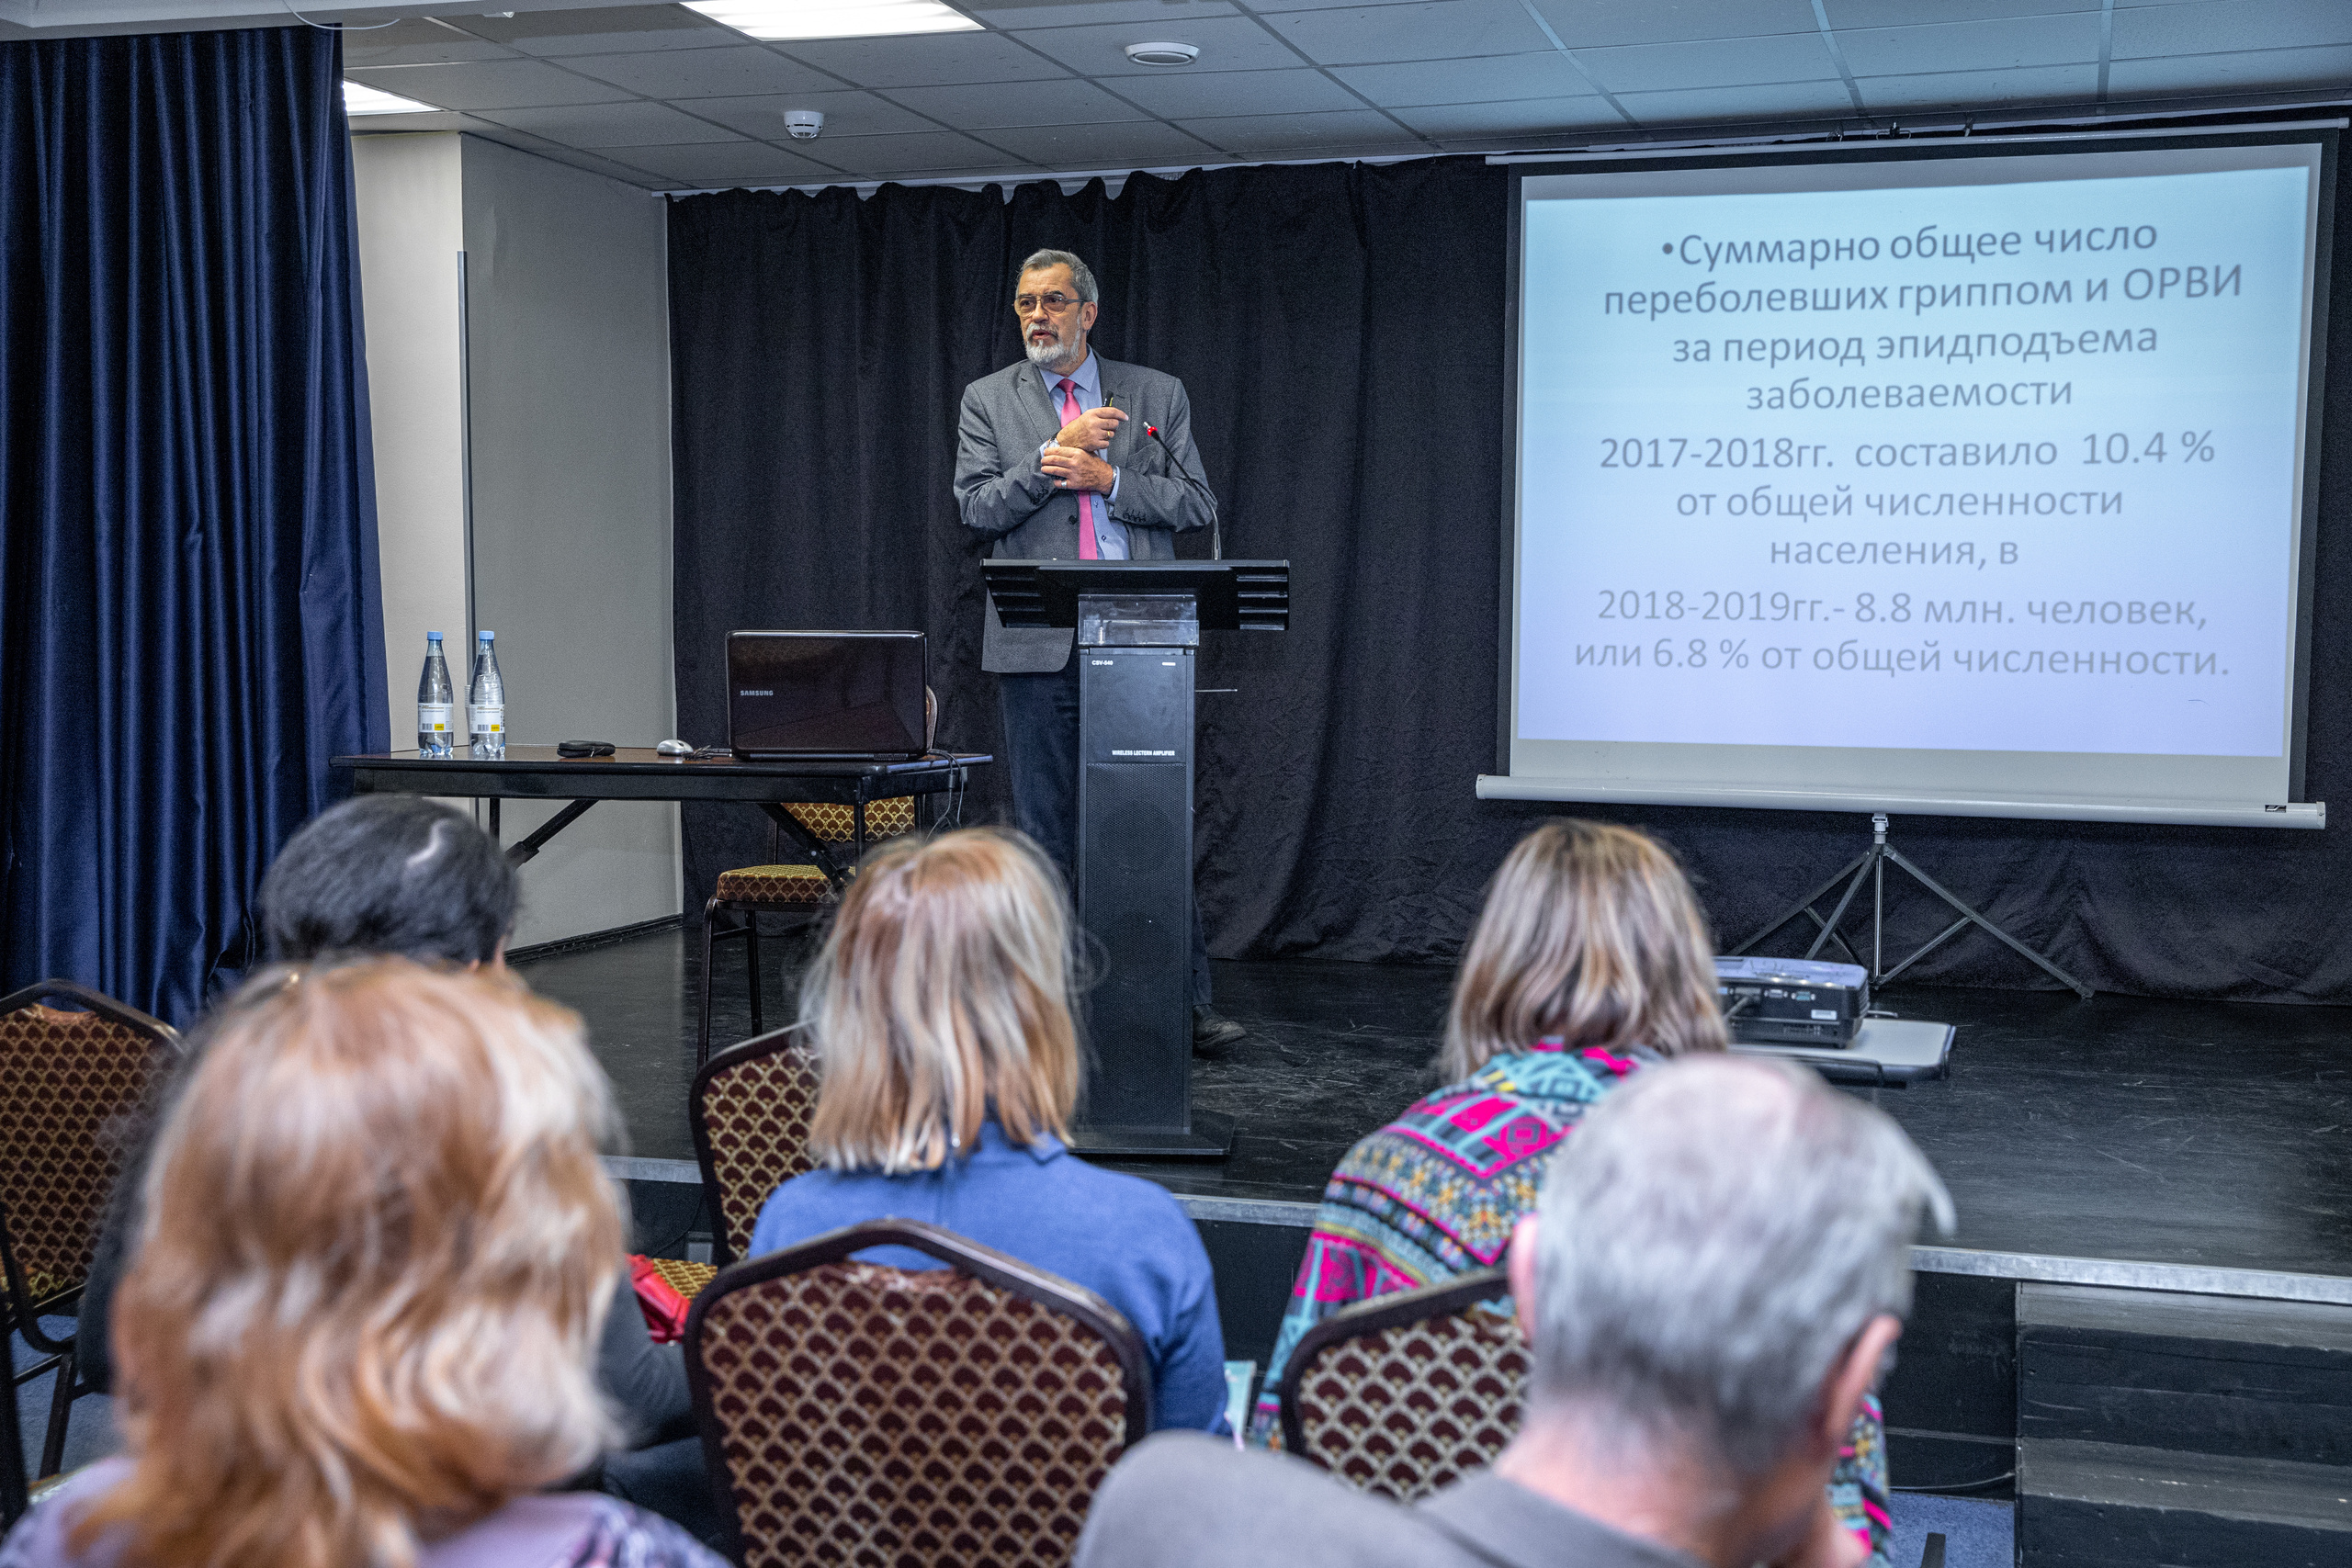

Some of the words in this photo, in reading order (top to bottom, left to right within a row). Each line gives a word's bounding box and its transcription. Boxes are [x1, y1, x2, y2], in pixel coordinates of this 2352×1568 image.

[1679, 233, 1882, 274] Суммарно
[1889, 223, 2023, 265] общее
[2033, 224, 2159, 254] число
[1604, 279, 1889, 322] переболевших
[1898, 278, 2074, 317] гриппом
[2085, 277, 2109, 303] и
[2122, 263, 2243, 301] ОРВИ
[1672, 338, 1712, 364] за
[1723, 336, 1867, 370] период
[1876, 326, 2158, 366] эпидподъема
[1747, 376, 2073, 411] заболеваемости
[1600, 436, 1834, 469] 2017-2018гг.
[1854, 441, 2059, 468] составило
[2082, 431, 2168, 466] 10.4
[2180, 429, 2215, 464] %
[1676, 492, 1717, 517] от
[1725, 483, 1853, 524] общей
[1864, 491, 2123, 517] численности
[1770, 541, 1987, 570] населения,
[1999, 541, 2019, 565] в
[1854, 592, 1912, 624] 8.8
[1924, 600, 2015, 624] млн.
[2027, 600, 2207, 630] человек,
[1576, 644, 1642, 667] или
[1653, 637, 1708, 669] 6.8
[1719, 638, 1749, 669] %
[1761, 646, 1803, 670] от
[1812, 638, 1940, 678] общей
[1953, 649, 2229, 675] численности.
